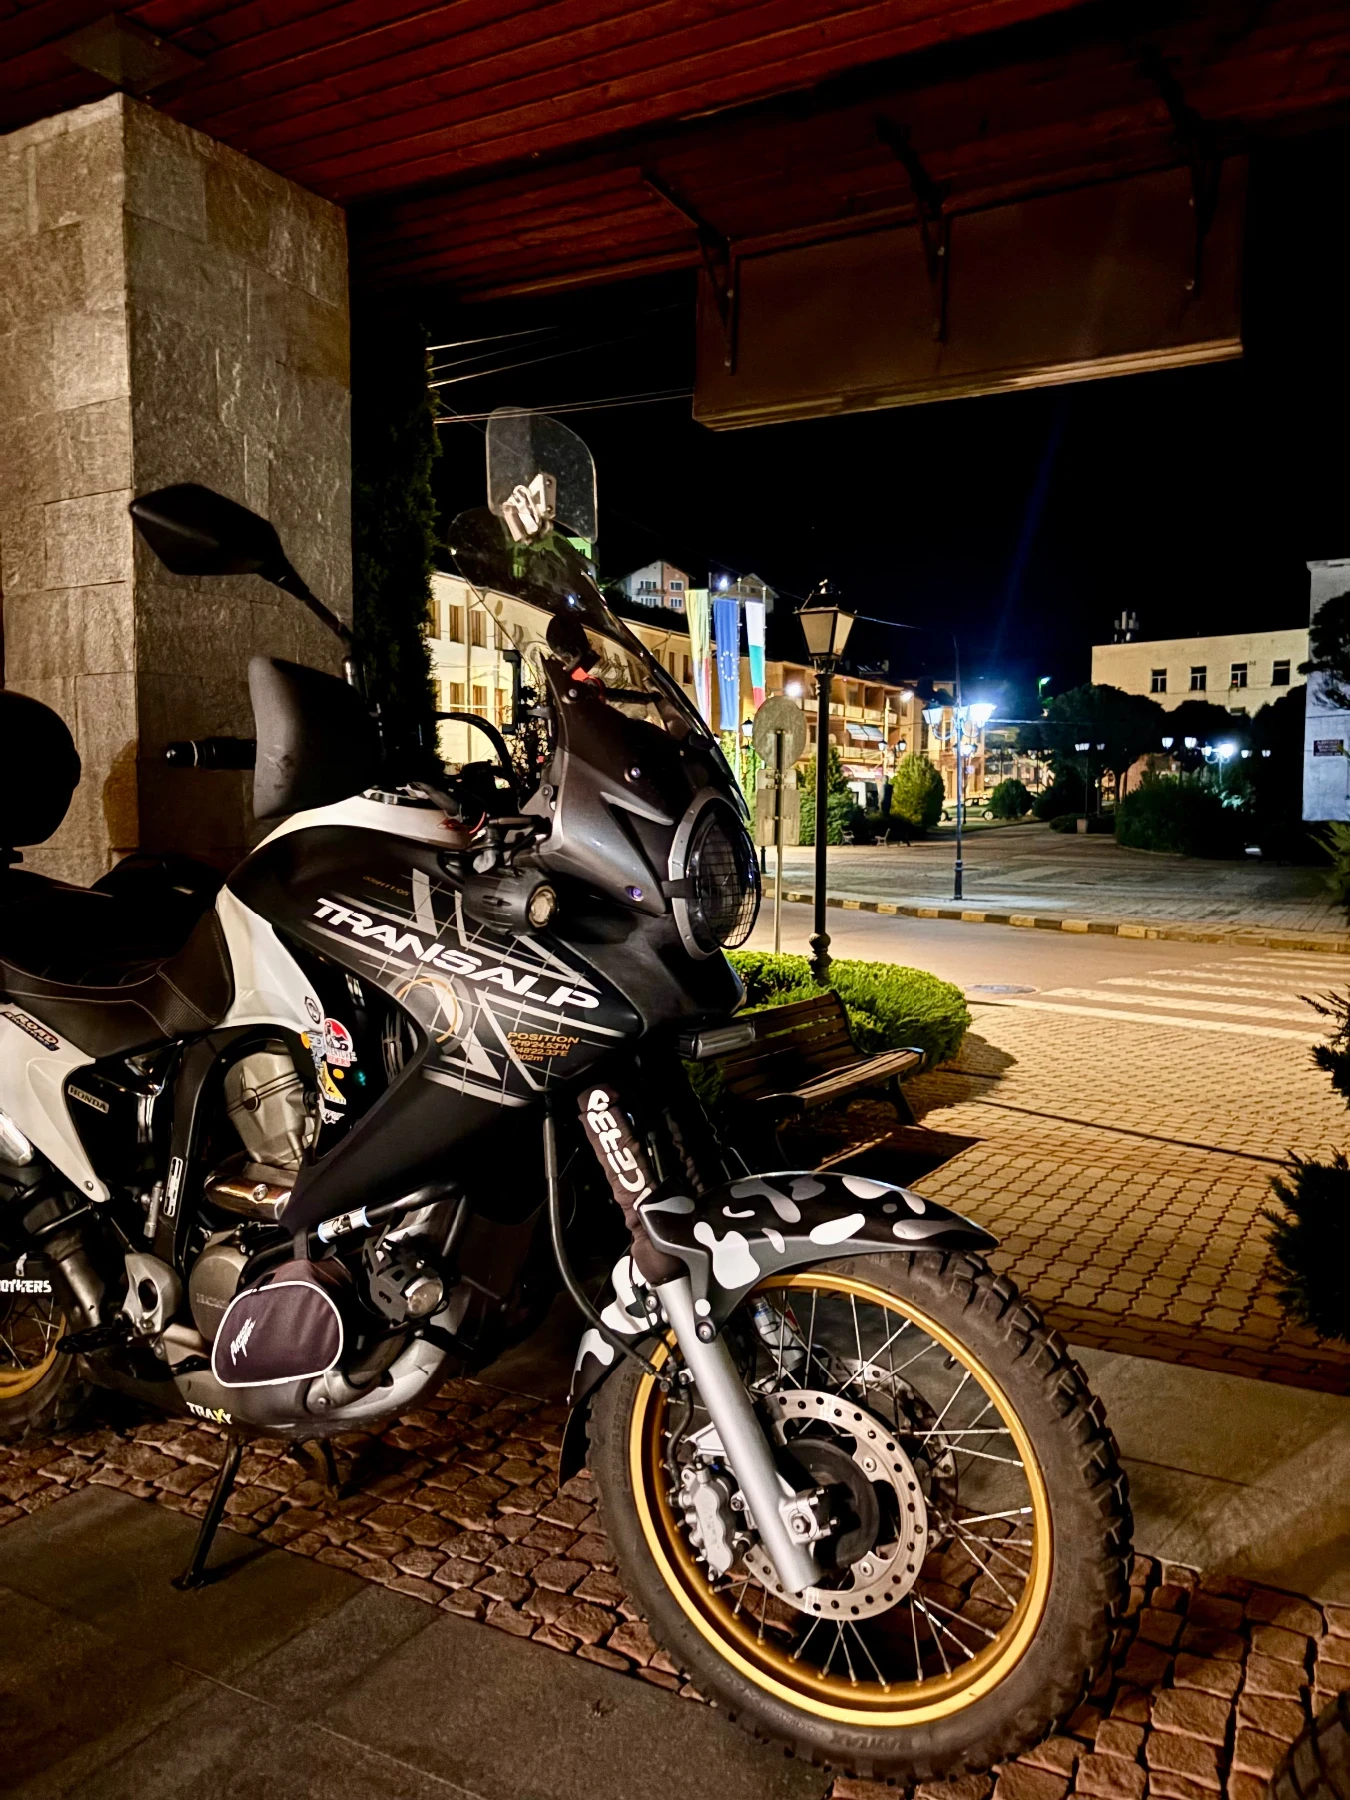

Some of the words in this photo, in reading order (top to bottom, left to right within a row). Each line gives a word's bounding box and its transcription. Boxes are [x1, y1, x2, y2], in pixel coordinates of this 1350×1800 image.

[313, 897, 600, 1009] TRANSALP
[15, 1014, 58, 1045] ROAD
[507, 1031, 579, 1044] POSITION
[69, 1086, 107, 1110] HONDA
